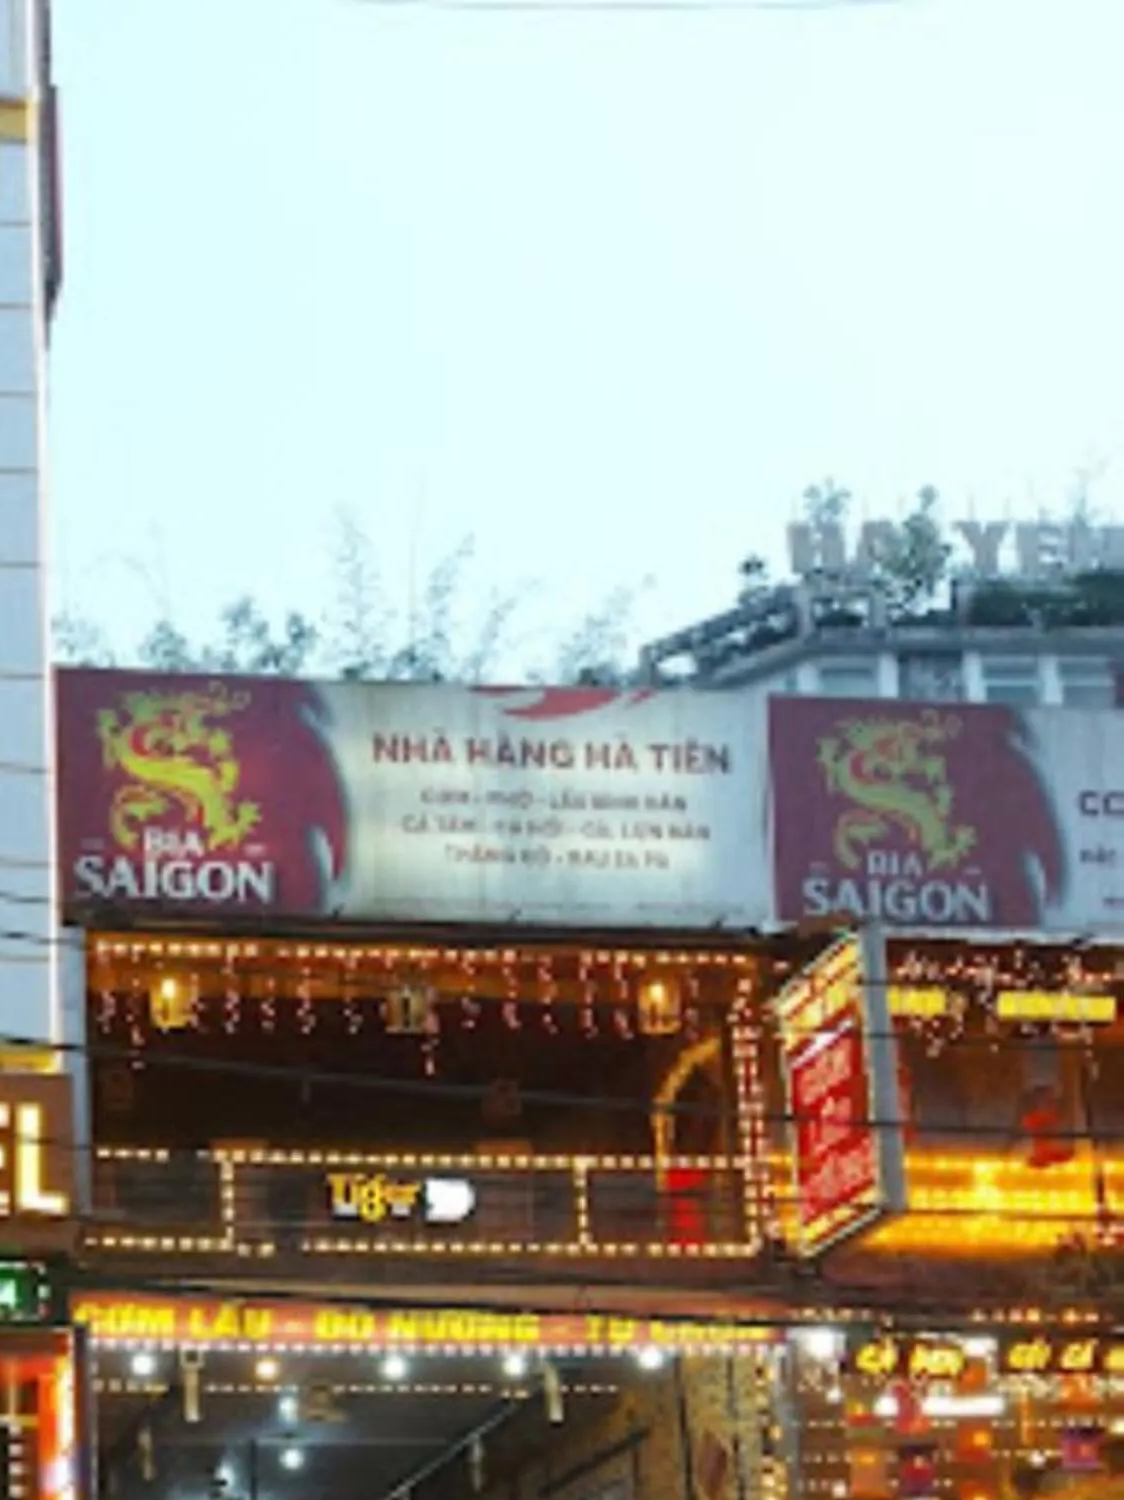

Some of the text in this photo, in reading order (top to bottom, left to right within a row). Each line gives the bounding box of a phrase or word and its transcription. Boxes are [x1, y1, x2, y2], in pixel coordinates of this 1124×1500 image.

[372, 731, 453, 765] NHÀ
[465, 731, 575, 771] HÀNG
[584, 733, 637, 771] HÀ
[74, 855, 274, 903] SAIGON
[802, 877, 993, 922] SAIGON
